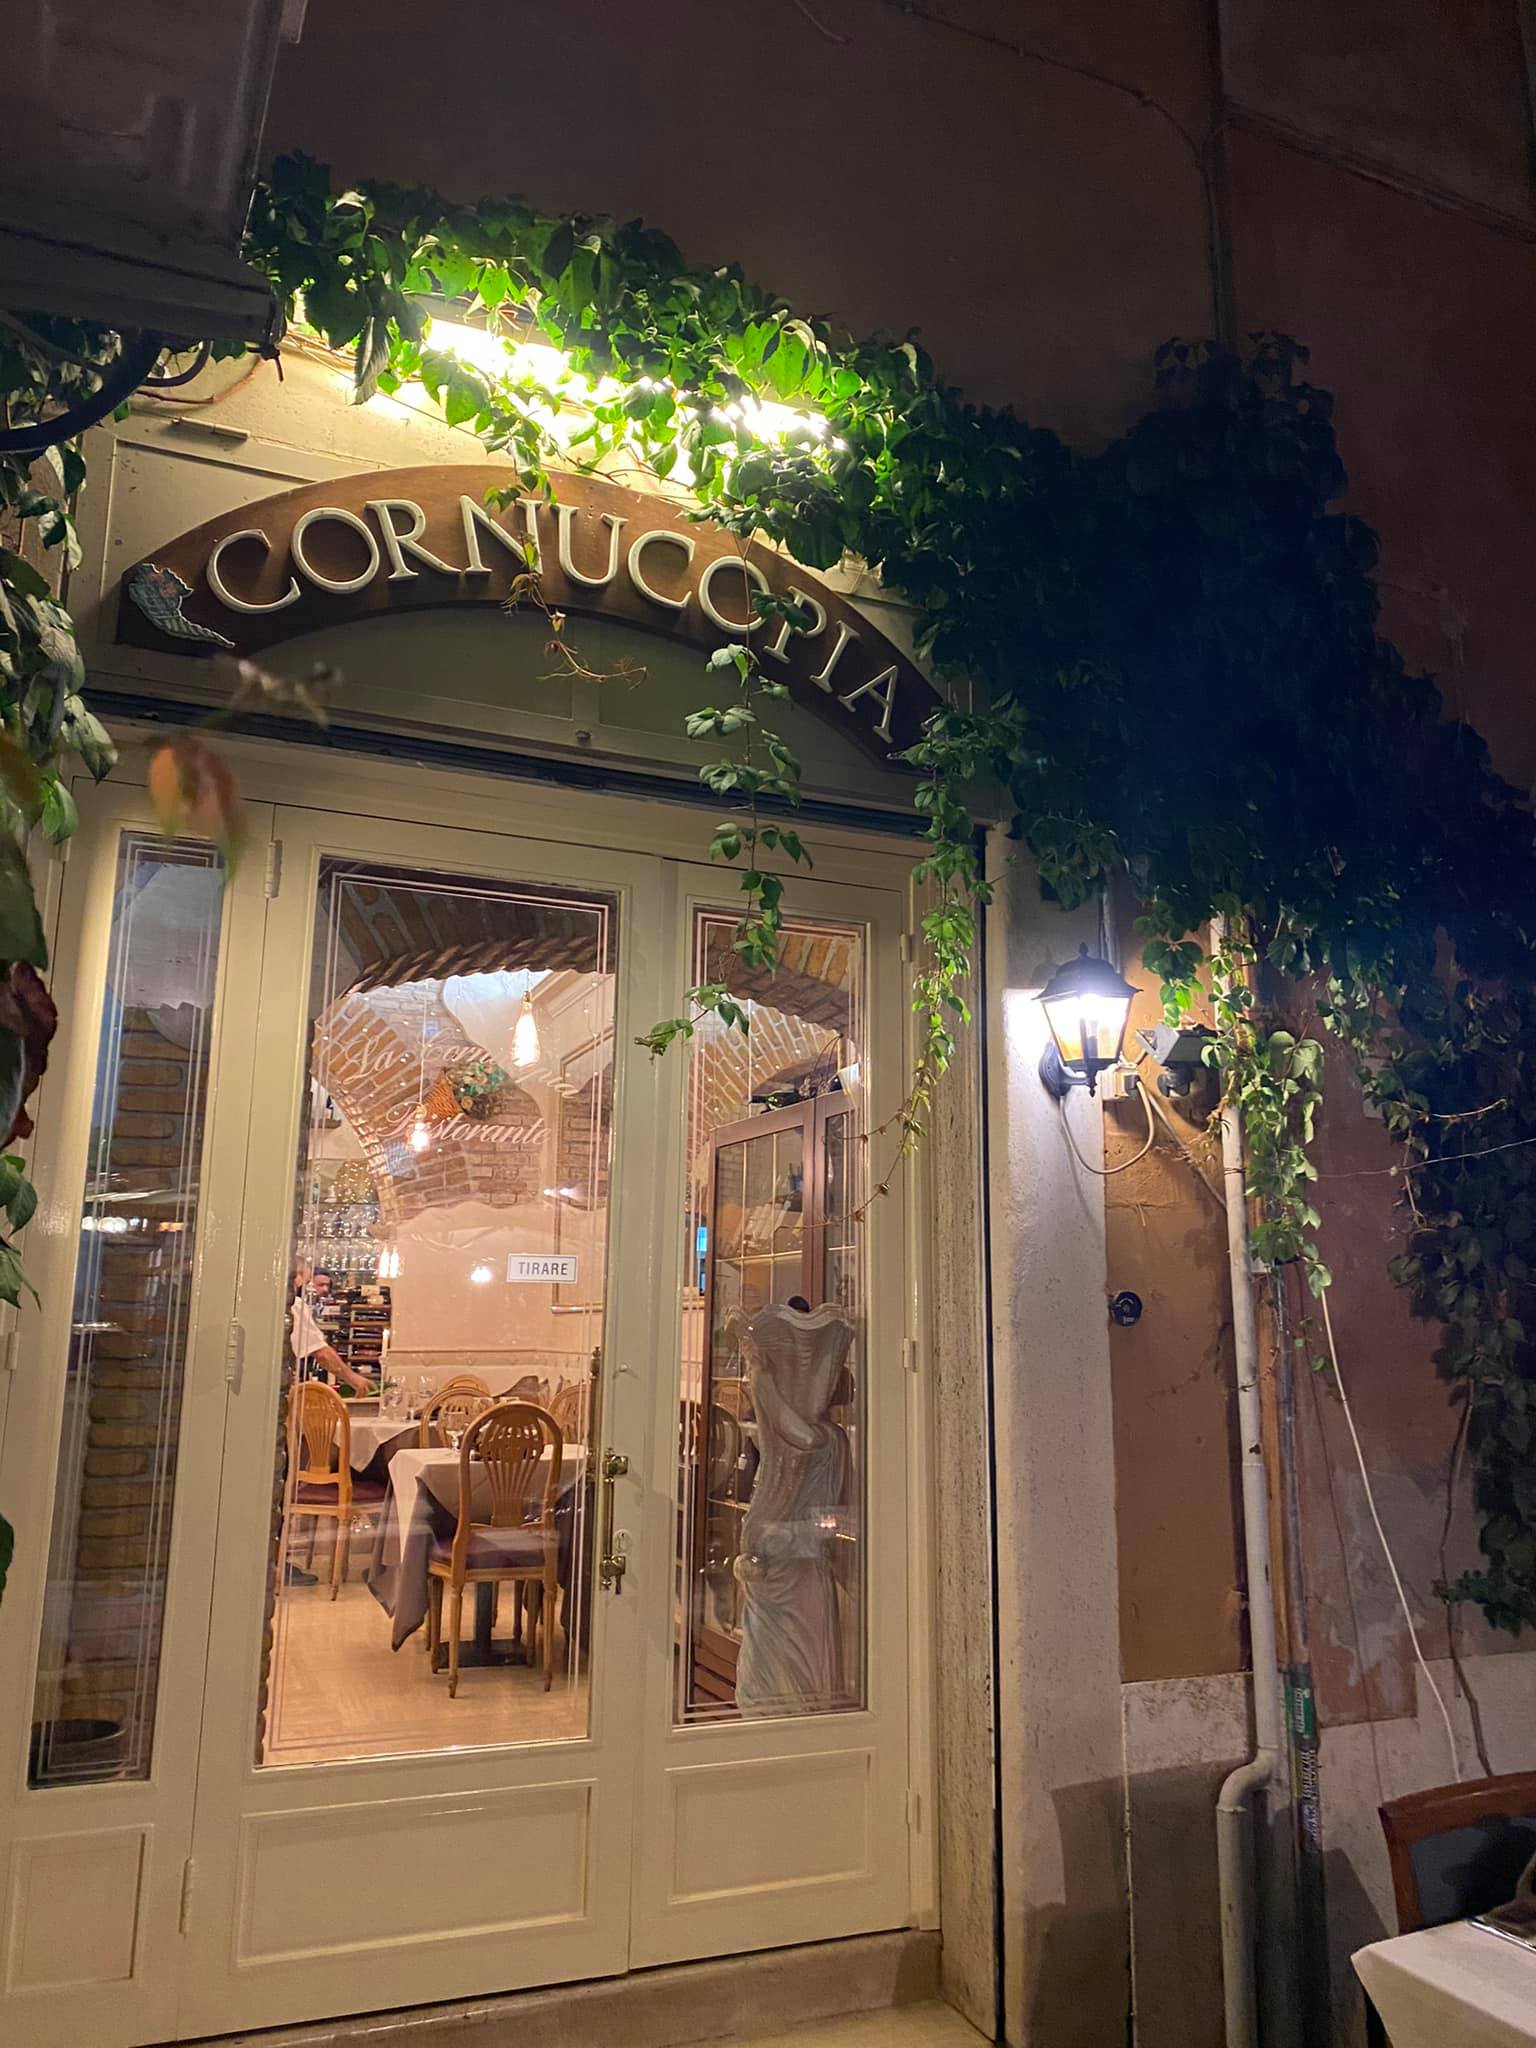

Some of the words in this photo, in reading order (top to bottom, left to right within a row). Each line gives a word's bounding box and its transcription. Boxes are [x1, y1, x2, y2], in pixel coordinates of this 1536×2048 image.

[206, 495, 900, 744] CORNUCOPIA
[342, 1035, 395, 1086] La
[375, 1101, 552, 1145] Rstorante
[517, 1261, 569, 1276] TIRARE
